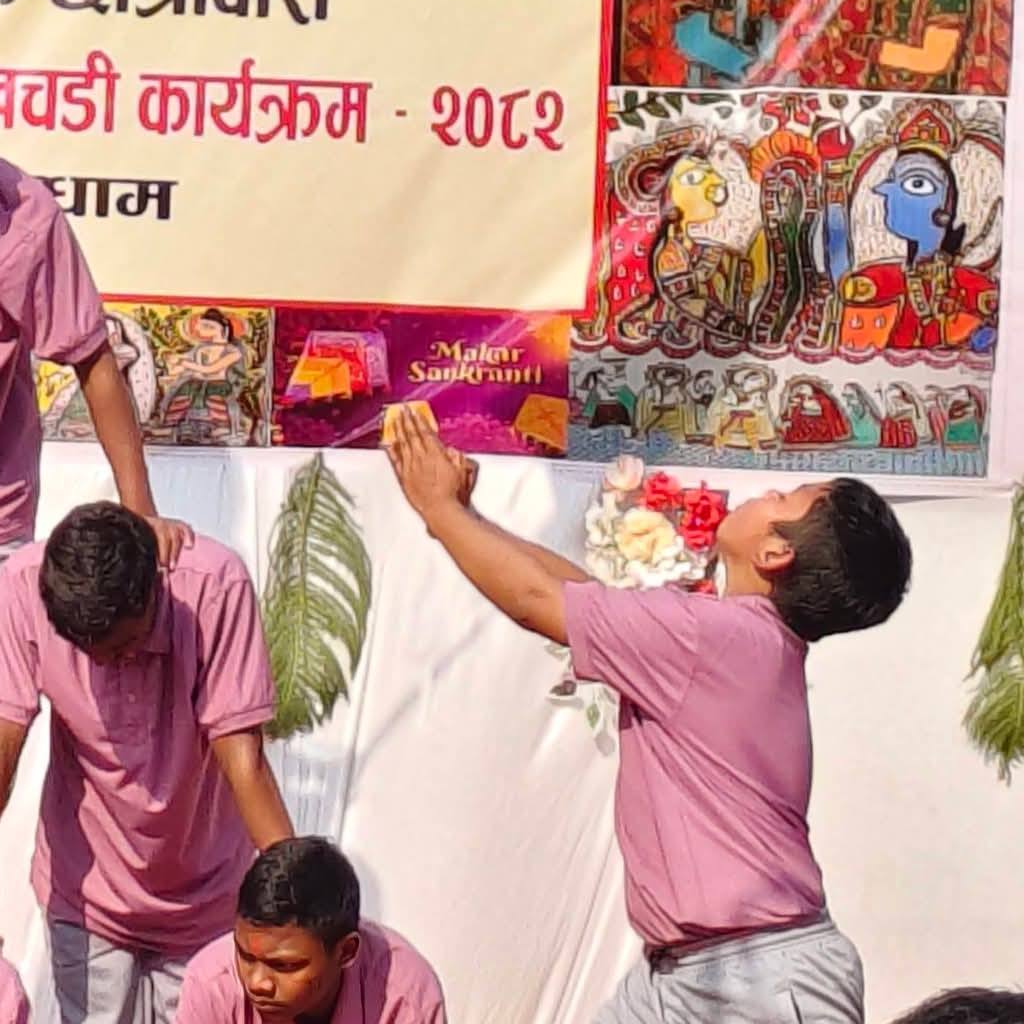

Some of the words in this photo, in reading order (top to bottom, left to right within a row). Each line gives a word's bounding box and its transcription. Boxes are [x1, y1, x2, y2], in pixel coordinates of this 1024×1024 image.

[138, 58, 373, 144] कार्यक्रम
[430, 85, 565, 152] २०८२
[428, 339, 526, 365] Makar
[407, 360, 544, 385] Sankranti
